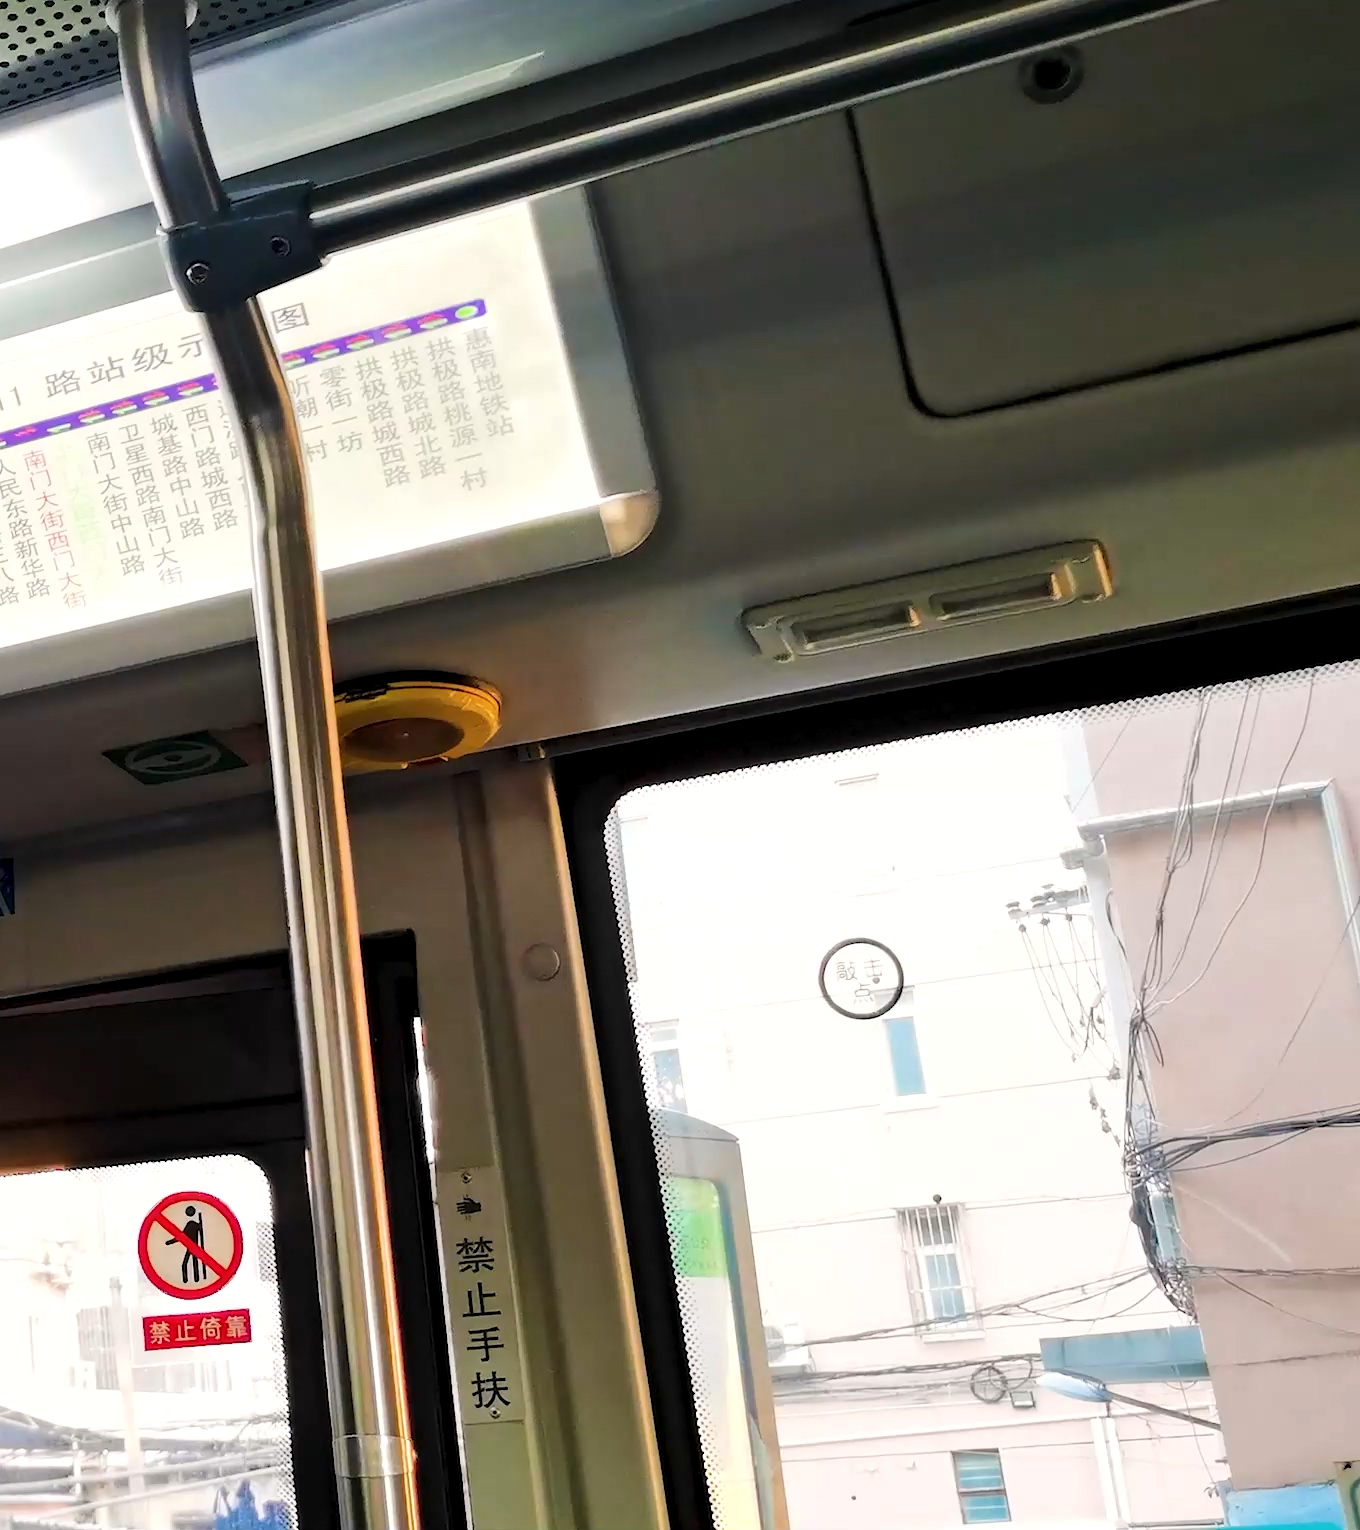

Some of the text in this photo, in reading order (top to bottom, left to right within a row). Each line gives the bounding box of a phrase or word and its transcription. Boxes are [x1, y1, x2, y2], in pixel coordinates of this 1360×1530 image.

[355, 355, 411, 488] 拱极路城西路
[390, 345, 447, 479] 拱极路城北路
[425, 336, 488, 491] 拱极路桃源一村
[463, 326, 515, 437] 惠南地铁站
[23, 449, 87, 610] 南门大街西门大街
[86, 431, 145, 576] 南门大街中山路
[119, 423, 184, 587] 卫星西路南门大街
[150, 413, 205, 539] 城基路中山路
[182, 403, 239, 531] 西门路城西路
[149, 1315, 248, 1345] 禁止倚靠
[456, 1236, 511, 1409] 禁止手扶
